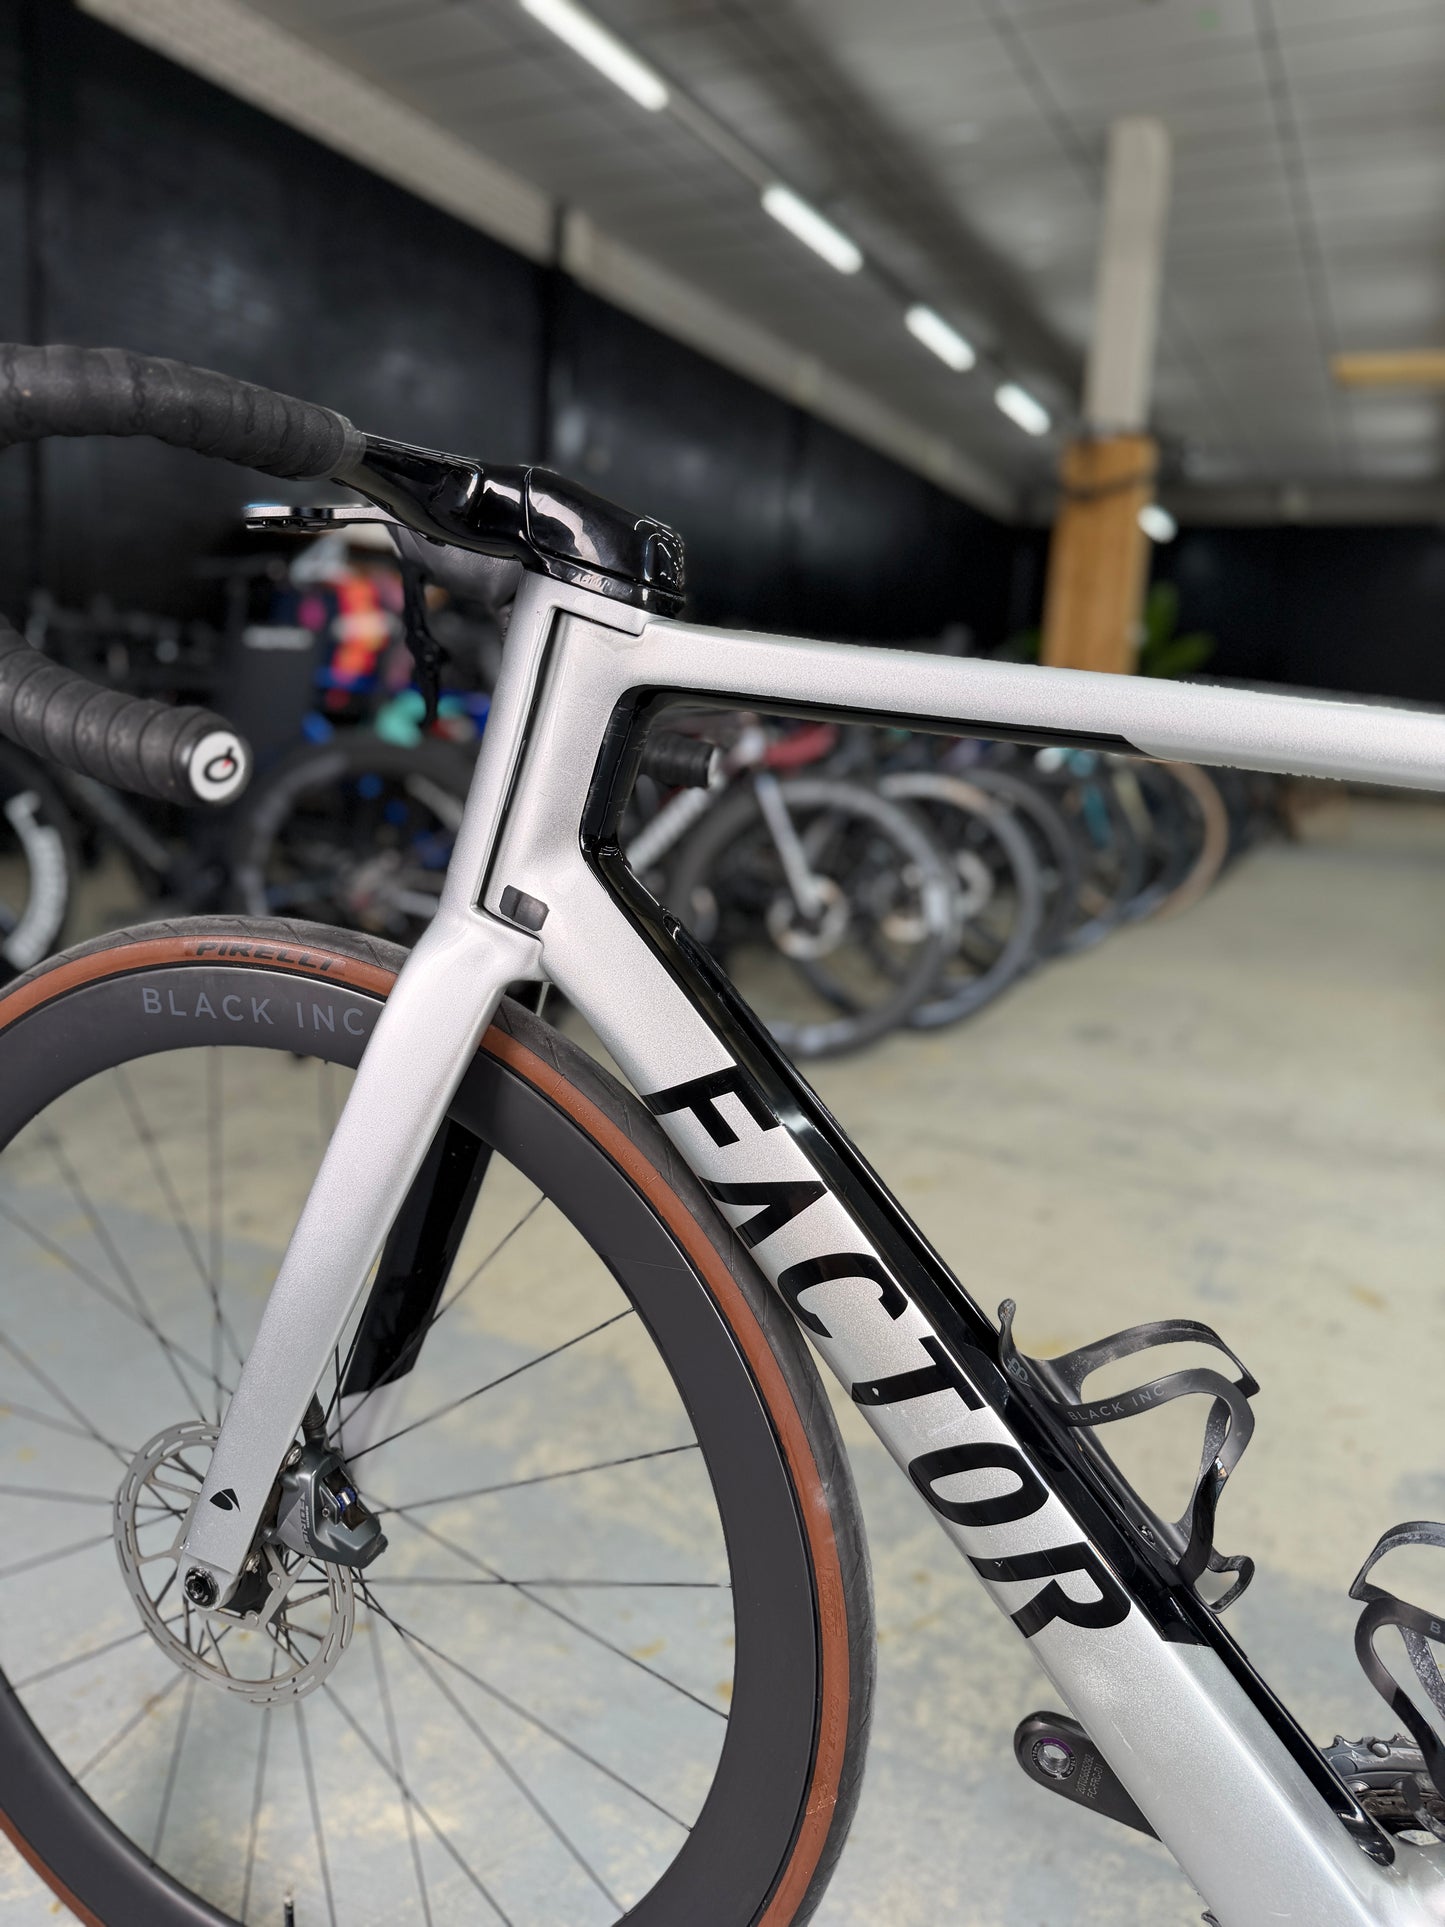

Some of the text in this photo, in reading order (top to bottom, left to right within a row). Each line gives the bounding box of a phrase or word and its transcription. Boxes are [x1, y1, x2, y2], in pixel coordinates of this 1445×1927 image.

[196, 942, 333, 971] PIRELLI
[142, 987, 365, 1036] BLACK INC
[640, 1065, 1131, 1638] FACTOR
[1067, 1385, 1165, 1421] BLACK INC
